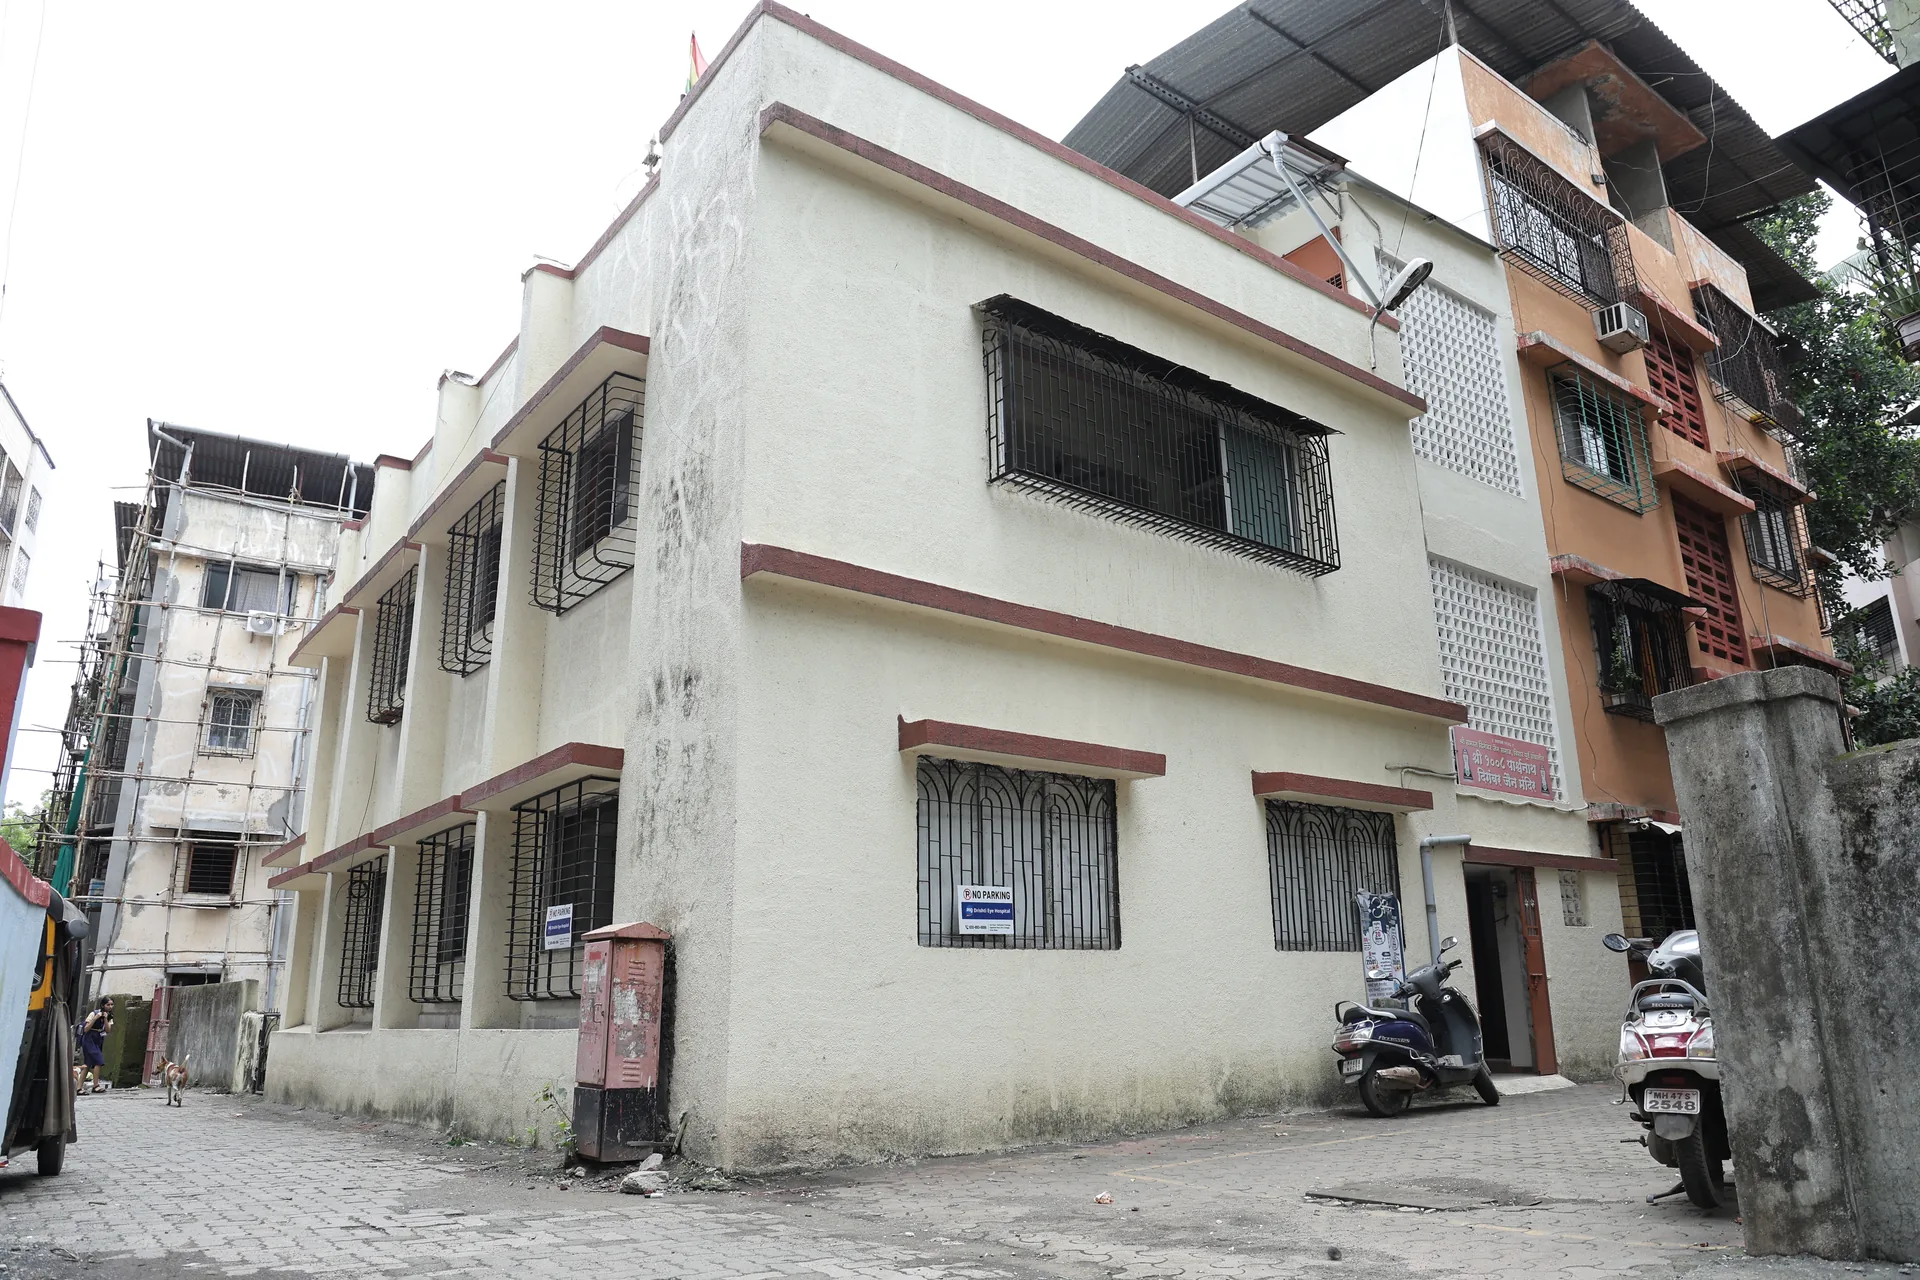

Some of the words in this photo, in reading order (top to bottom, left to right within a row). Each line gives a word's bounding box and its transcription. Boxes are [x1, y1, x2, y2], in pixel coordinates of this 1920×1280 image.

[1473, 750, 1482, 764] श्री
[1485, 755, 1506, 769] १००८
[1477, 768, 1501, 786] दिगंबर
[1503, 773, 1517, 788] जैन
[1519, 776, 1537, 792] मंदिर
[972, 890, 981, 899] NO
[982, 891, 1010, 900] PARKING
[1649, 1100, 1696, 1110] 2548
